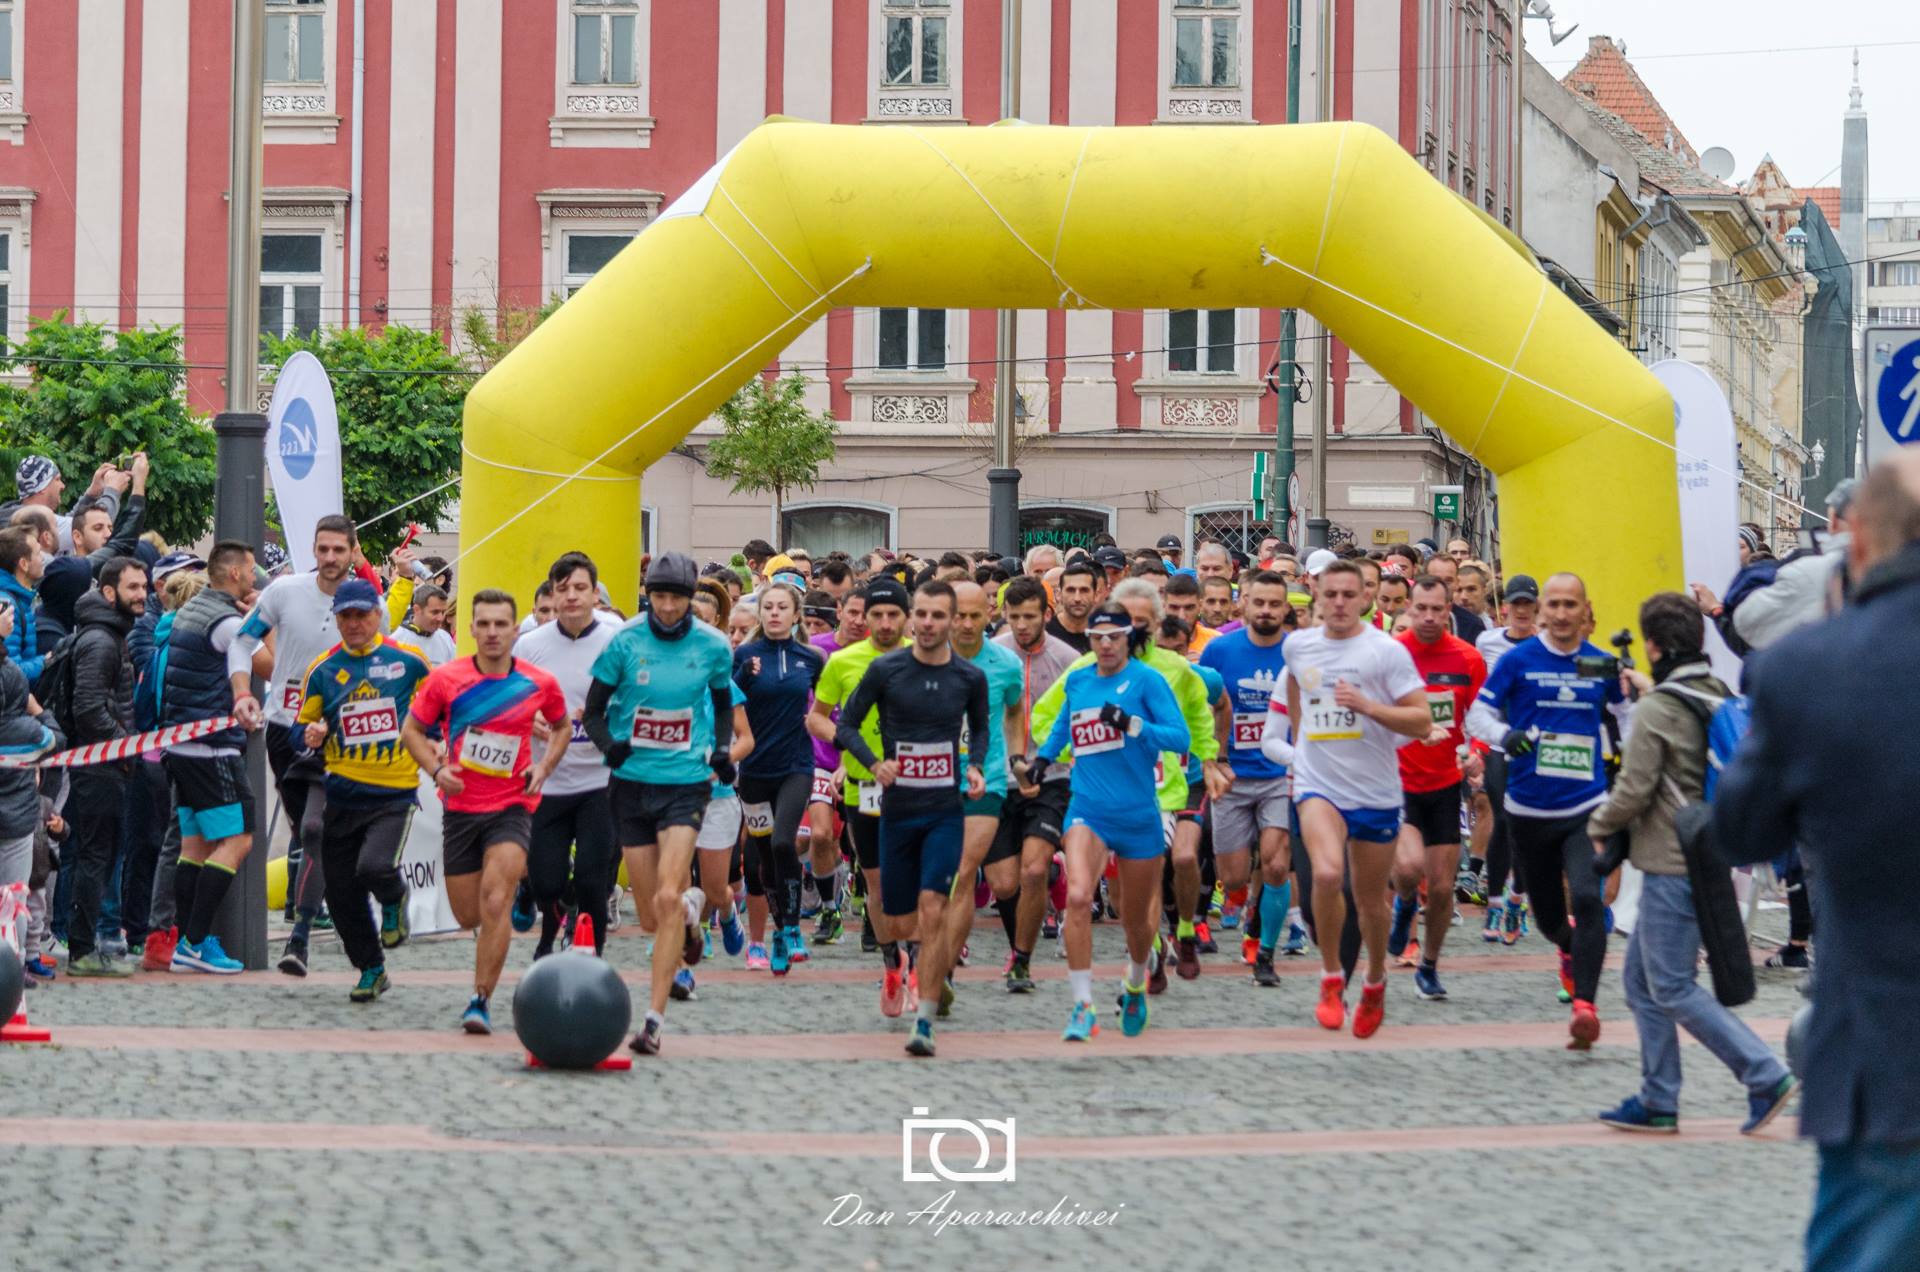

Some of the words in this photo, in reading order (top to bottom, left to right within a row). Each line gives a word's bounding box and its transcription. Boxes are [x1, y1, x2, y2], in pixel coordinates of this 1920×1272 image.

[348, 712, 393, 734] 2193
[1313, 711, 1356, 727] 1179
[638, 723, 685, 741] 2124
[470, 743, 513, 765] 1075
[1541, 748, 1590, 768] 2212A
[903, 759, 949, 777] 2123
